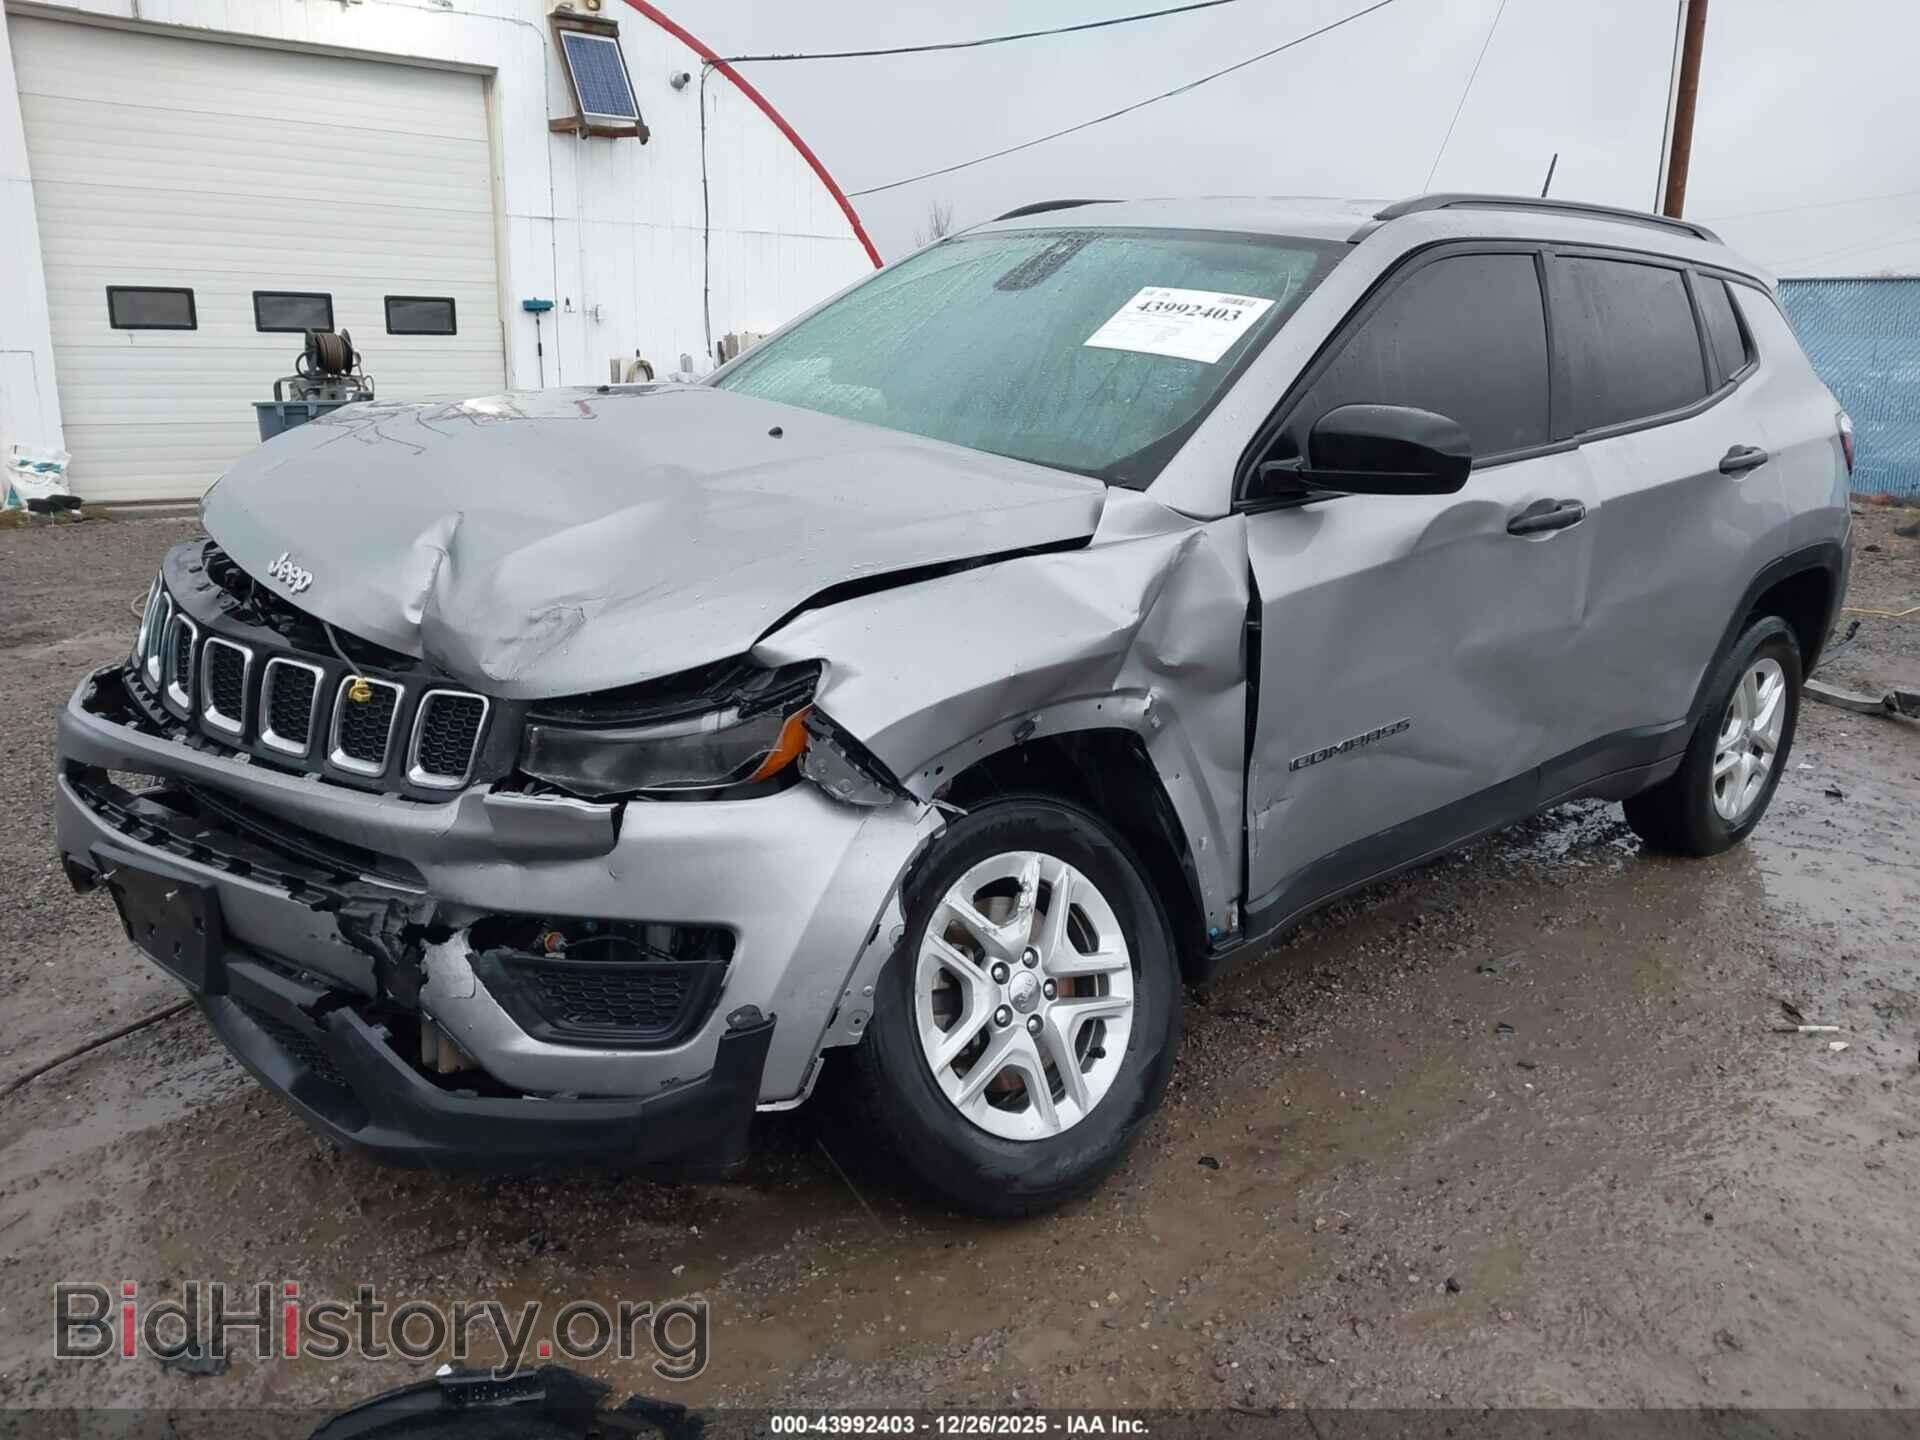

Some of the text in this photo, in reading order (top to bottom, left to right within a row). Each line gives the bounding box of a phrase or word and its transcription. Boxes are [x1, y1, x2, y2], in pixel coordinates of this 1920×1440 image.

[1136, 300, 1242, 321] 43992403
[268, 552, 313, 595] Jeep
[1289, 717, 1411, 772] COMPASS
